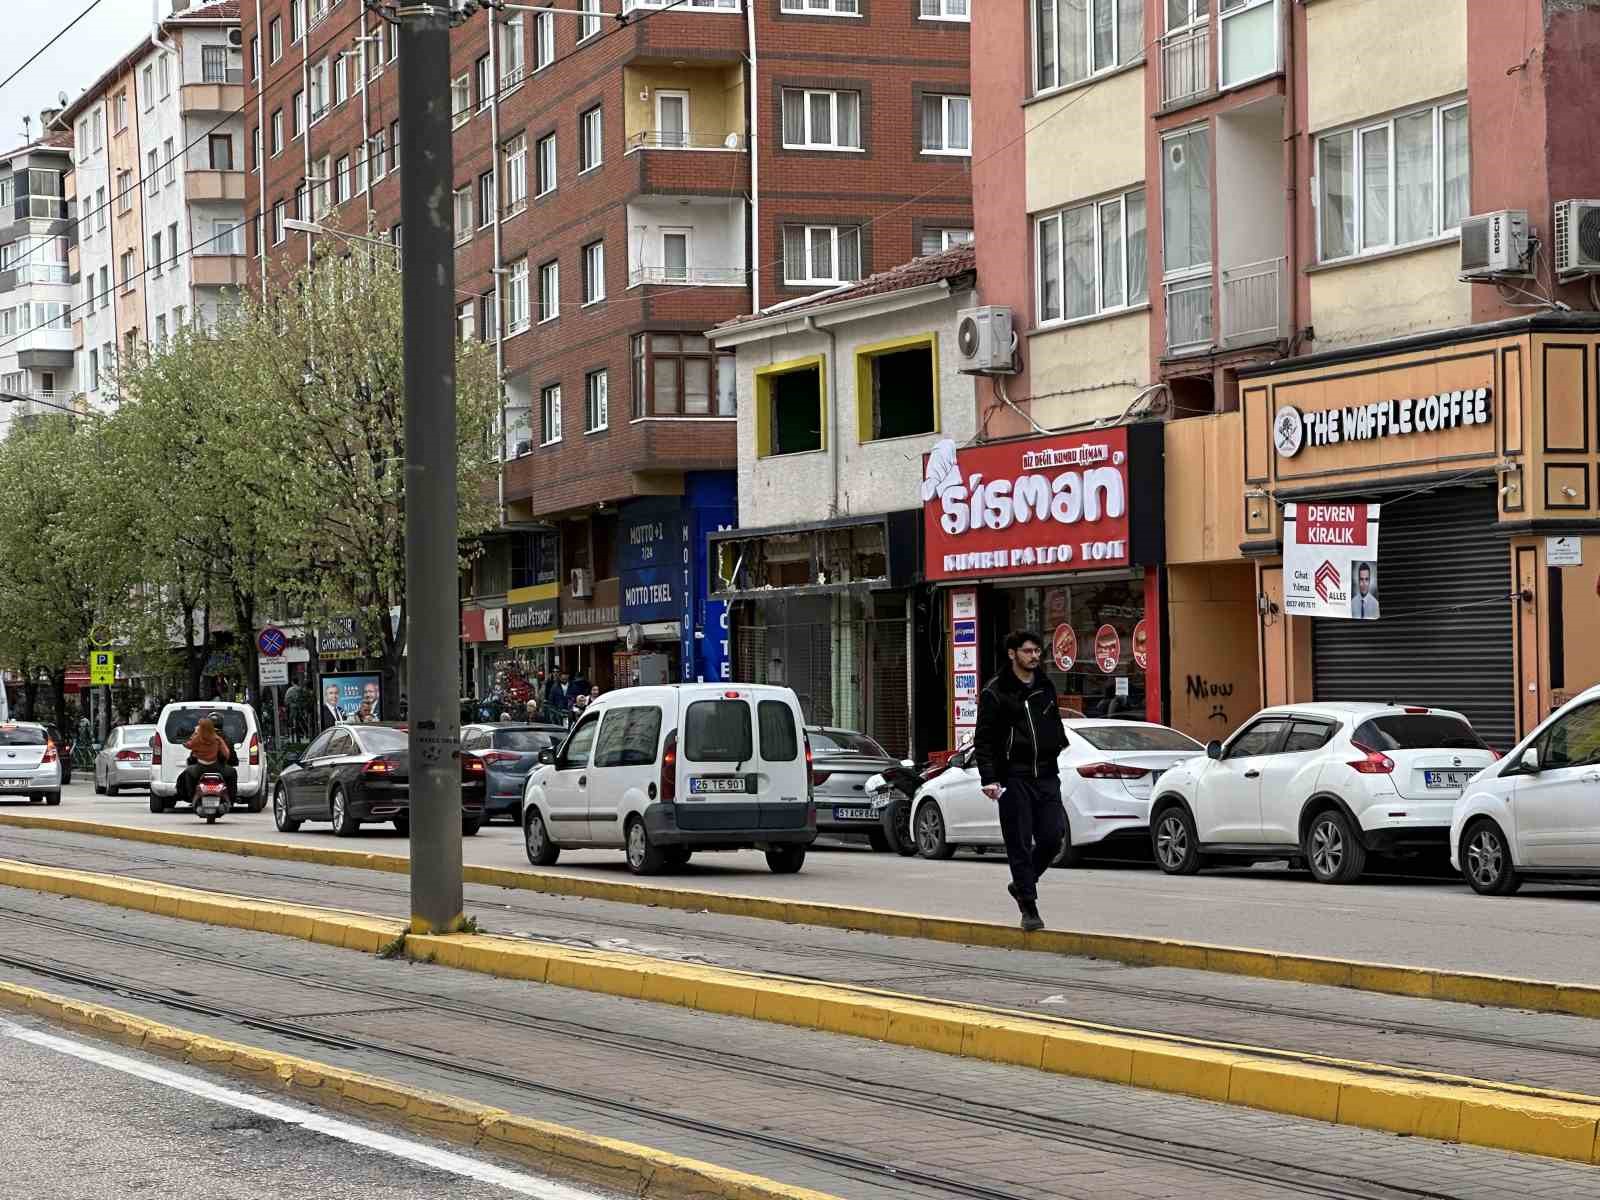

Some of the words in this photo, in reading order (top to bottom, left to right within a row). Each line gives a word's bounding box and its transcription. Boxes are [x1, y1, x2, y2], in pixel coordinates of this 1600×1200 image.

[1303, 409, 1341, 448] THE
[1343, 399, 1412, 442] WAFFLE
[1415, 387, 1488, 433] COFFEE
[1308, 506, 1355, 522] DEVREN
[1308, 522, 1354, 544] KİRALIK
[1294, 570, 1308, 580] Cihat
[625, 587, 649, 606] MOTTO
[649, 583, 672, 604] TEKEL
[1328, 592, 1346, 601] ALLES
[955, 674, 976, 689] SETCARD
[696, 780, 708, 789] 26
[712, 780, 726, 789] TE
[727, 779, 744, 789] 901
[1431, 772, 1442, 783] 26
